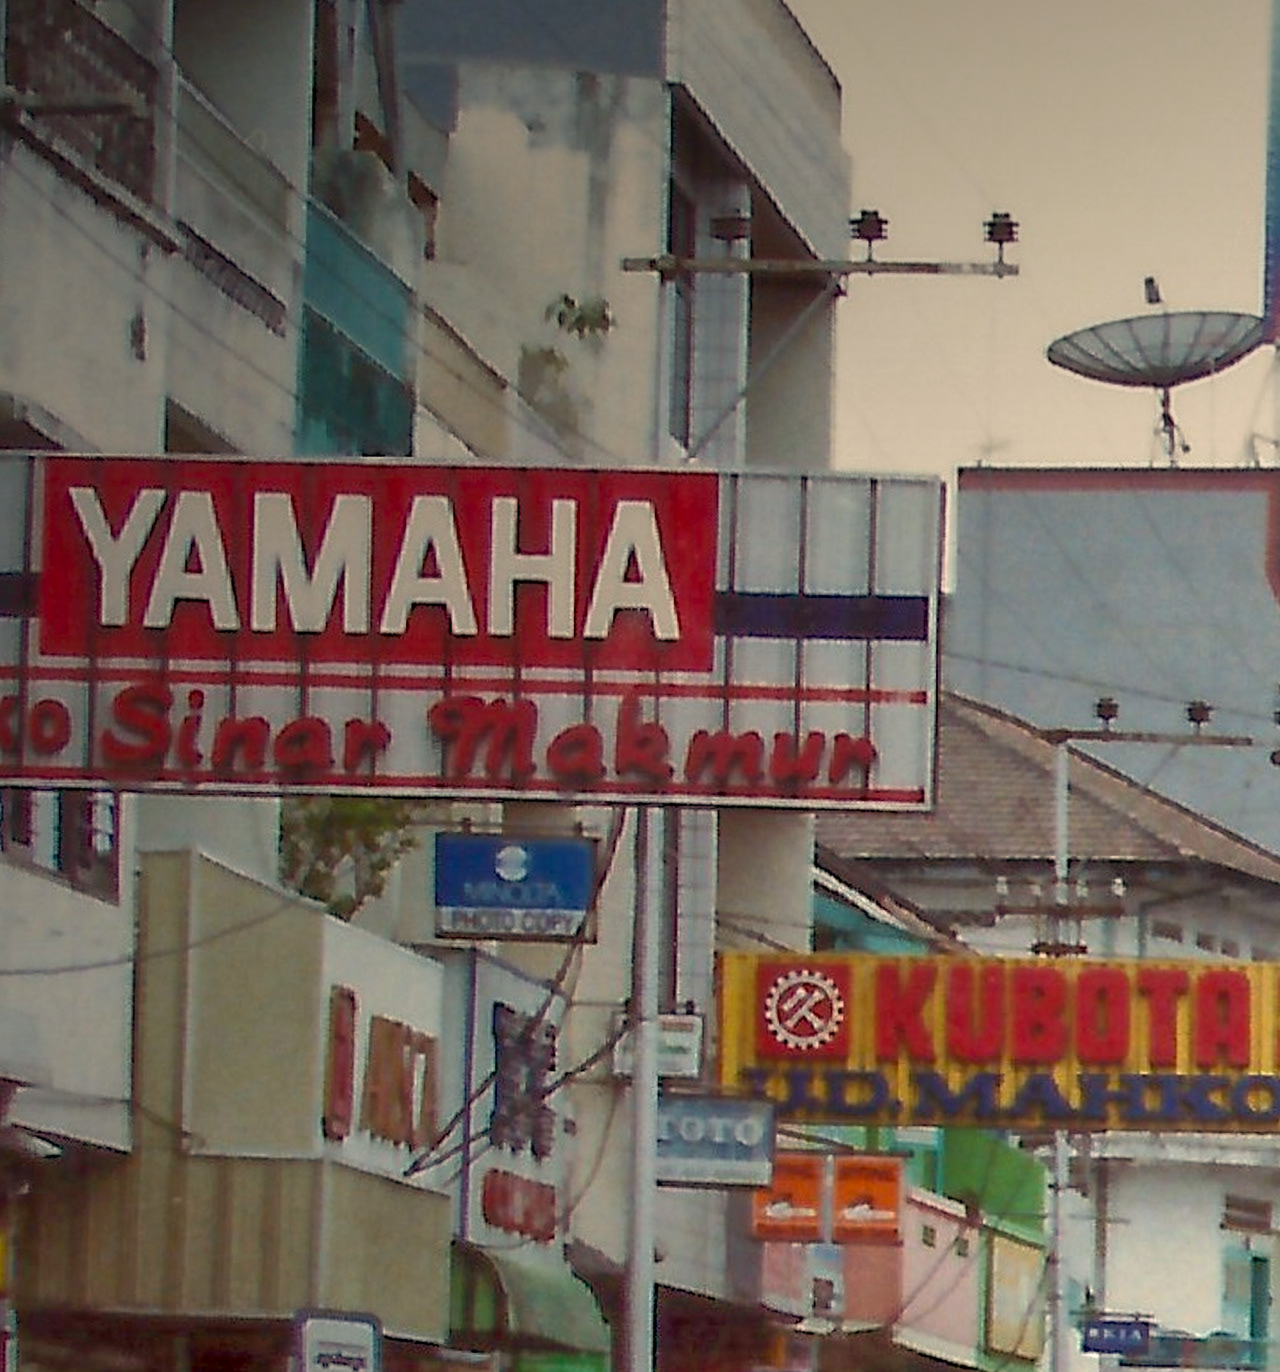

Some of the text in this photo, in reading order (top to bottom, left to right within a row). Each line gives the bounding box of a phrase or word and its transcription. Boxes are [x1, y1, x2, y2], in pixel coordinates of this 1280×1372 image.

[69, 486, 680, 641] YAMAHA
[101, 682, 392, 770] Sinar
[429, 690, 877, 788] Makmur
[876, 962, 1250, 1067] KUBOTA
